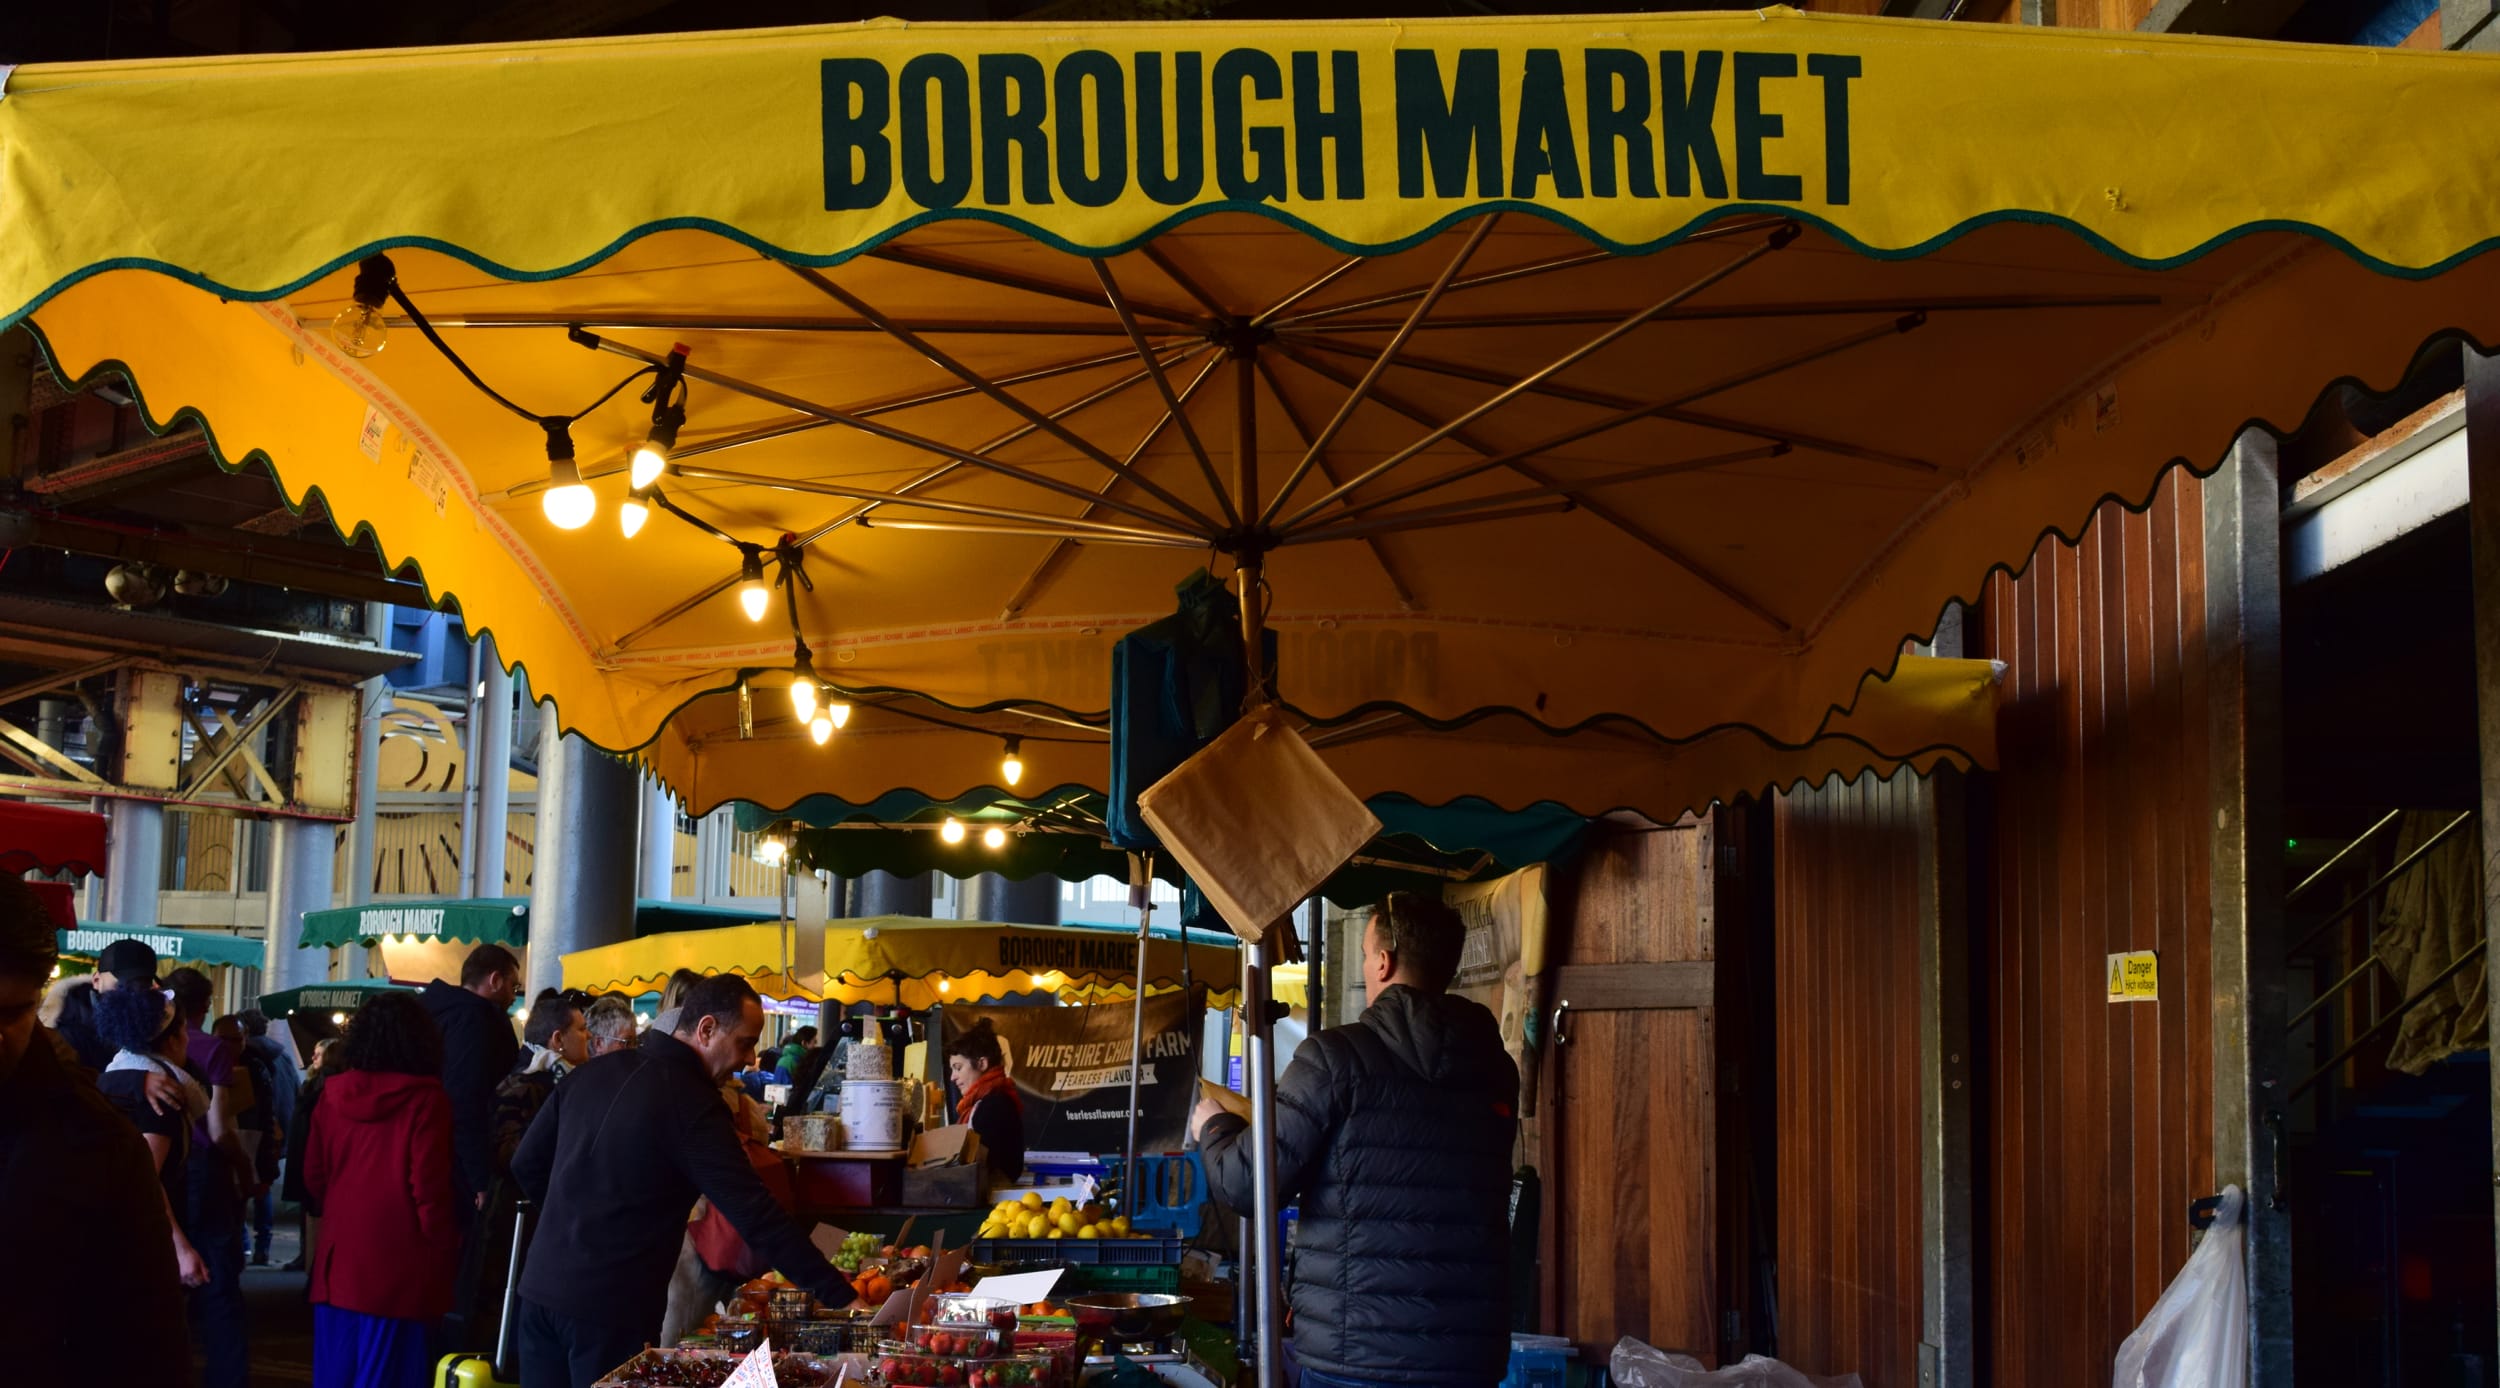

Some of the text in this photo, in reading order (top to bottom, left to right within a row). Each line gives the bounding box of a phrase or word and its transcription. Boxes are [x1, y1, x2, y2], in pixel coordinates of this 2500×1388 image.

[822, 49, 1863, 211] BOROUGH MARKET
[359, 909, 444, 935] BOROUGH MARKET
[1000, 936, 1136, 970] BOROUGH MARKE
[2128, 960, 2152, 977] Danger
[1026, 1043, 1105, 1068] WILTSHIRE
